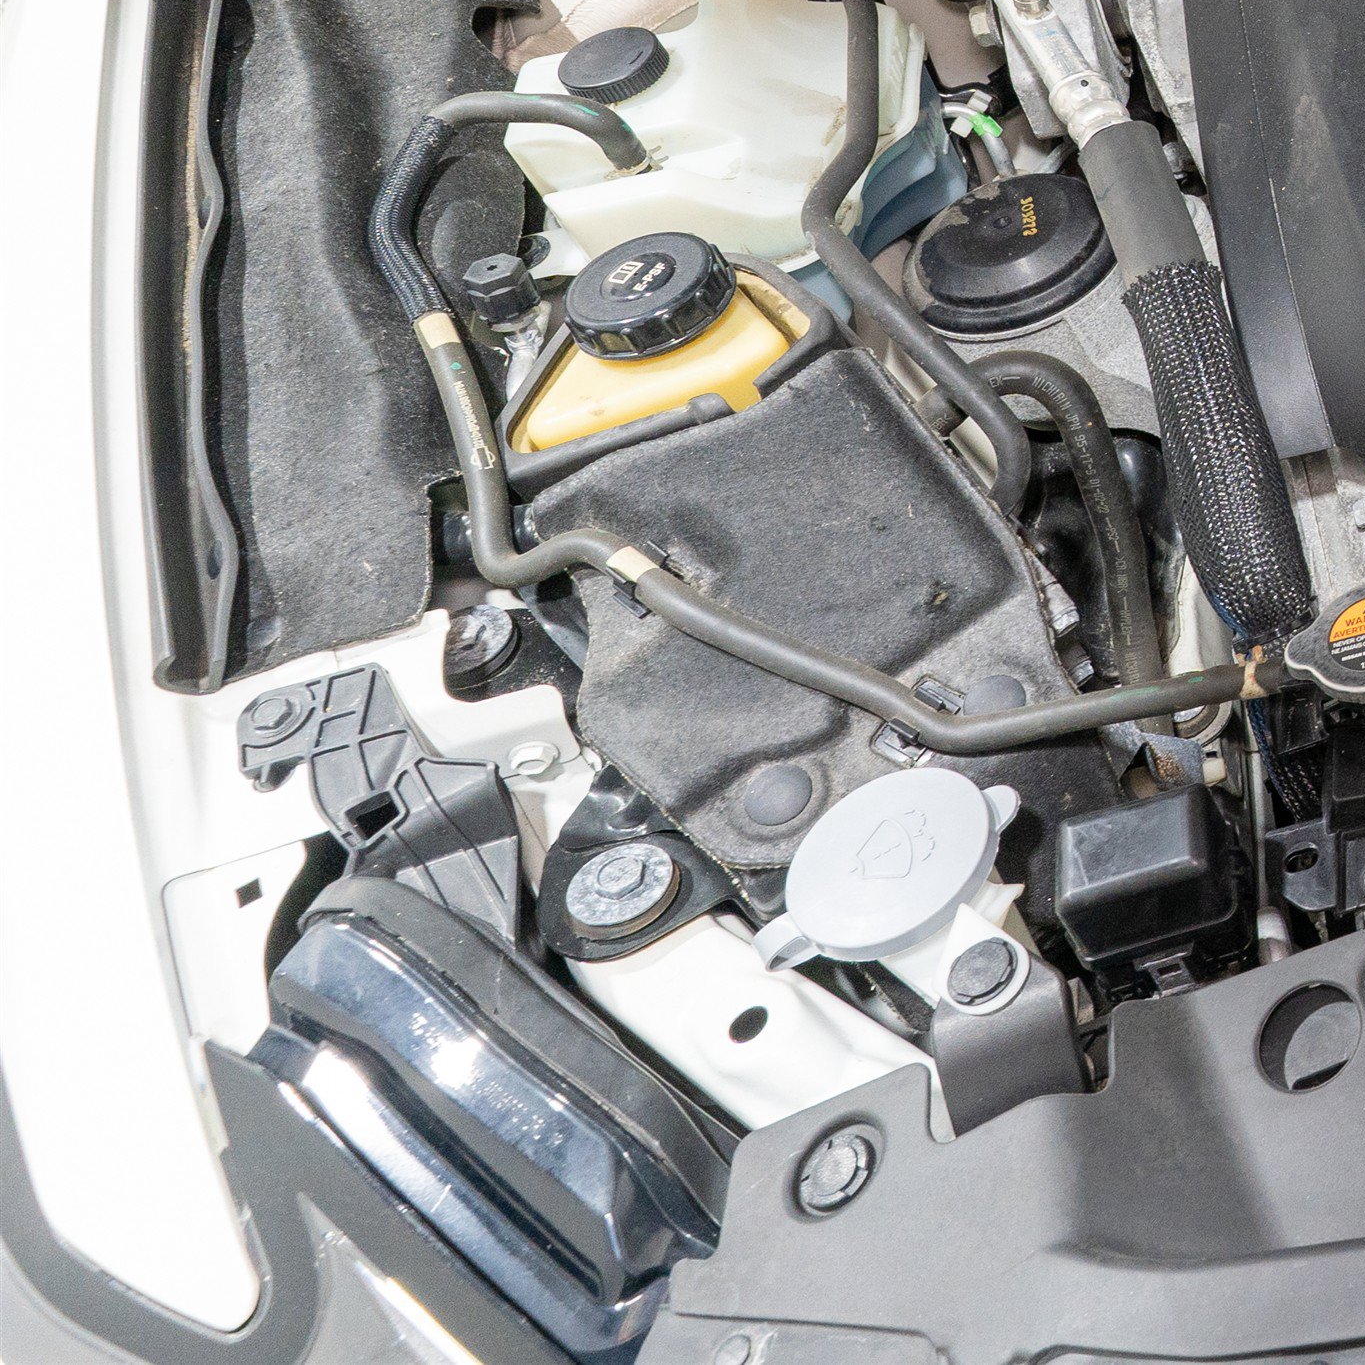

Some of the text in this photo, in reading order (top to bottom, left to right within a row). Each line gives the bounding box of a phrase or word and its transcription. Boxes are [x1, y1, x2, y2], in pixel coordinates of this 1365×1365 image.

[632, 262, 667, 292] E-PSF
[1031, 376, 1073, 410] NICHIRIN
[1065, 413, 1081, 431] JPN
[1331, 637, 1355, 648] NEVER
[1338, 642, 1363, 652] JAMAIS
